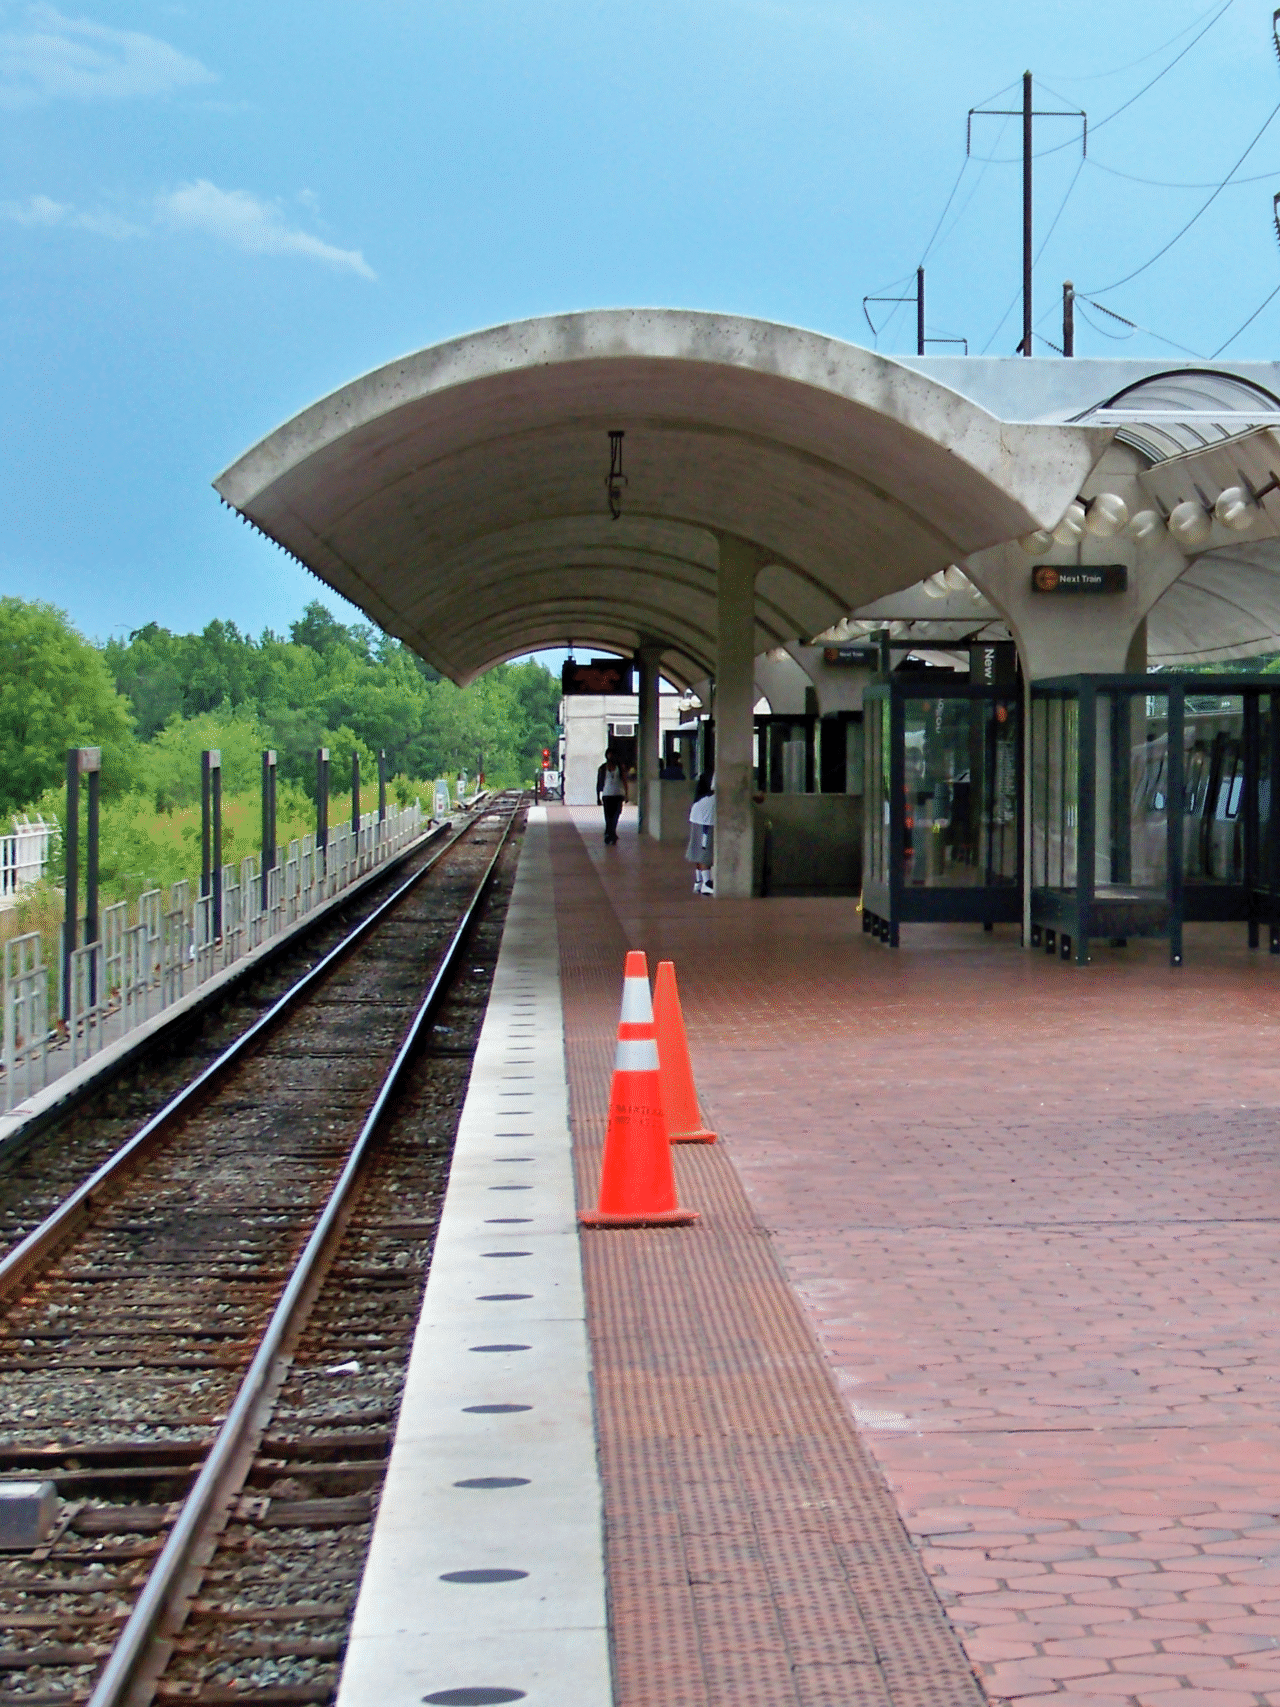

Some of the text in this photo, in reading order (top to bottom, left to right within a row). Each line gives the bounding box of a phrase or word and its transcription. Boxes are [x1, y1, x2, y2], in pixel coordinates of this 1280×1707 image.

[1060, 575, 1102, 583] Next Train
[985, 649, 995, 679] New
